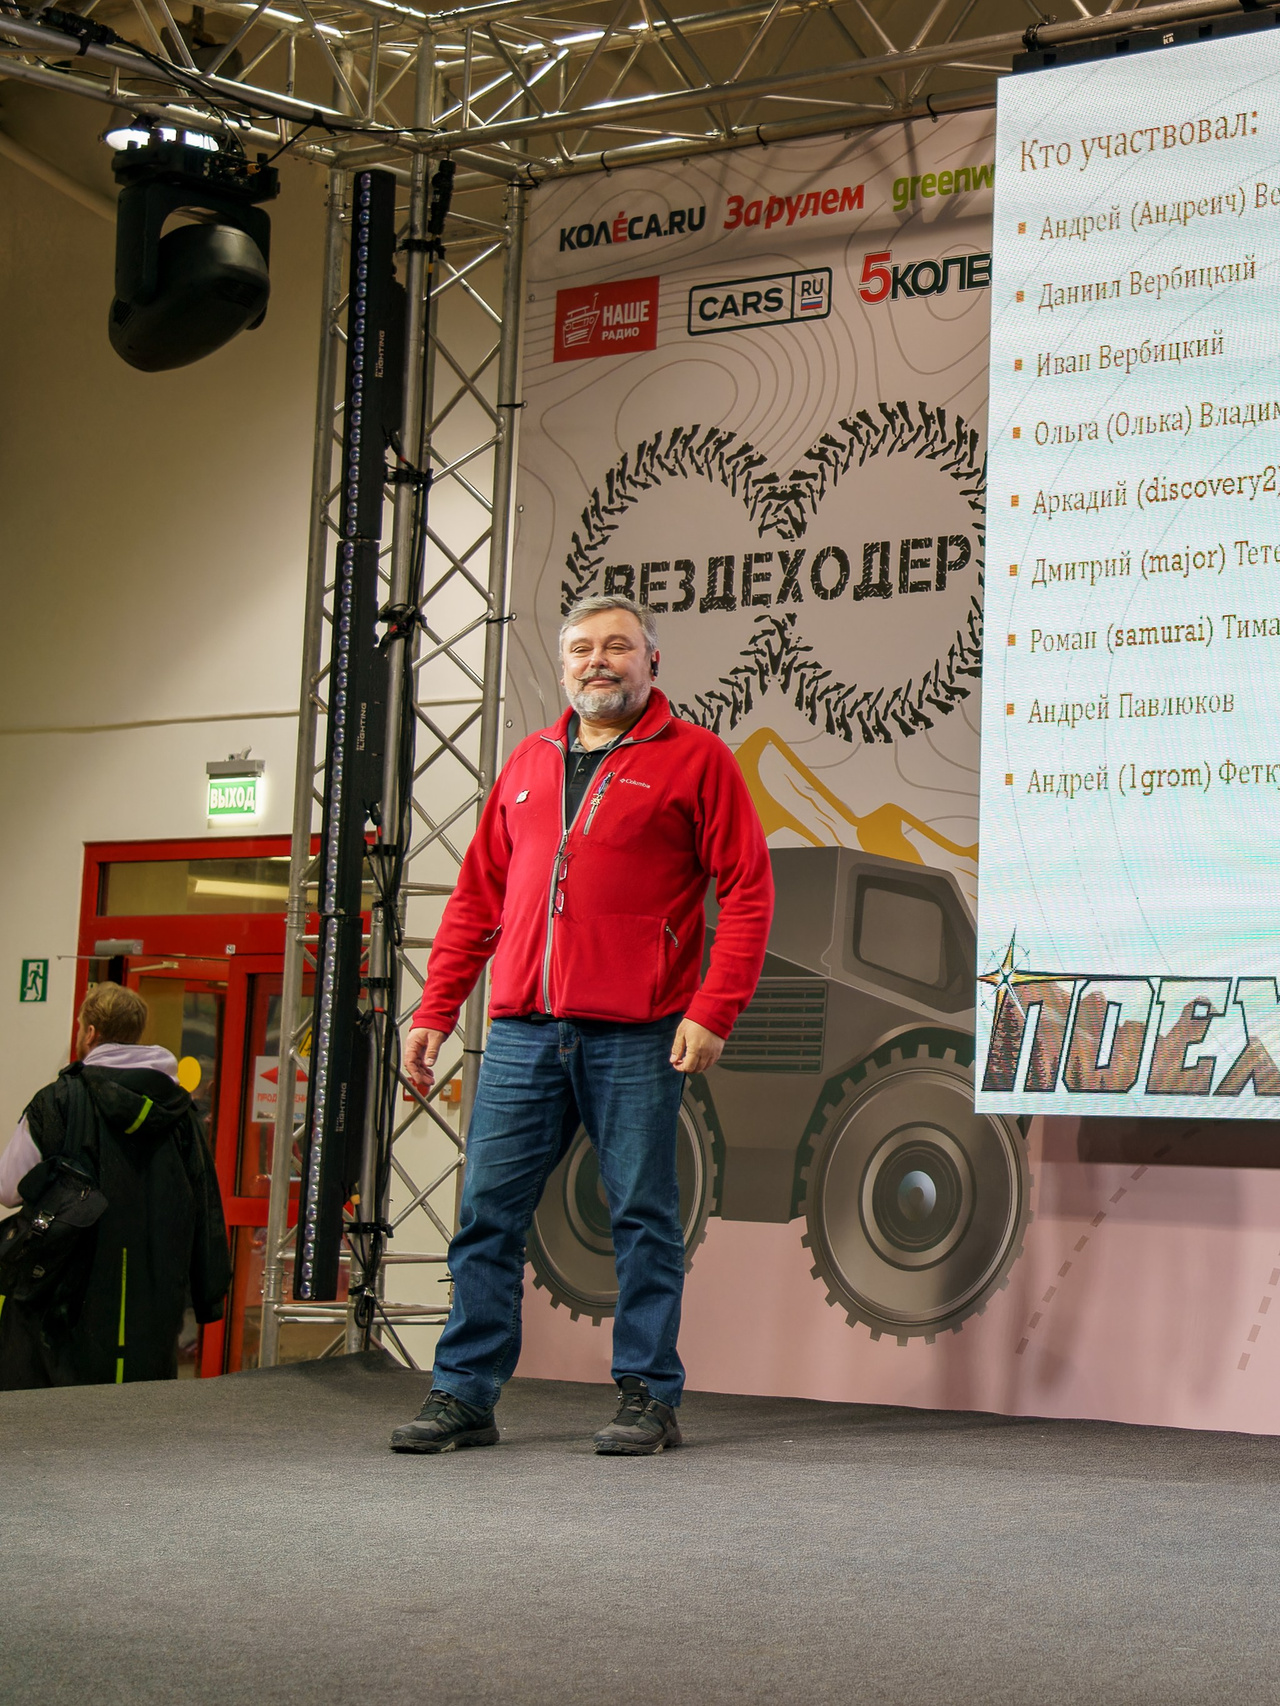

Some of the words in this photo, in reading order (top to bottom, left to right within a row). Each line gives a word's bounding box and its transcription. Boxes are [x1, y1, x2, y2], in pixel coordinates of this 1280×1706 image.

[1020, 139, 1071, 172] Кто
[1080, 110, 1258, 171] участвовал:
[1039, 206, 1120, 243] Андрей
[1130, 188, 1246, 233] (Андреич)
[699, 287, 784, 322] CARS
[800, 277, 824, 297] RU
[859, 251, 992, 304] 5КОЛЕ
[1038, 279, 1121, 313] Даниил
[1129, 255, 1256, 300] Вербицкий
[602, 299, 650, 328] НАШЕ
[602, 325, 640, 342] РАДИО
[1037, 350, 1091, 378] Иван
[1099, 329, 1224, 374] Вербицкий
[1034, 414, 1099, 448] Ольга
[1107, 404, 1192, 444] (Олька)
[1032, 482, 1128, 520] Аркадий
[603, 535, 972, 614] ВЕЗДЕХОДЕР
[1032, 551, 1131, 589] Дмитрий
[1141, 543, 1226, 580] (major)
[1031, 626, 1097, 654] Роман
[1107, 616, 1213, 654] (samurai)
[1028, 693, 1109, 729] Андрей
[1119, 692, 1235, 720] Павлюков
[210, 786, 254, 812] ВЫХОД
[1027, 765, 1109, 800] Андрей
